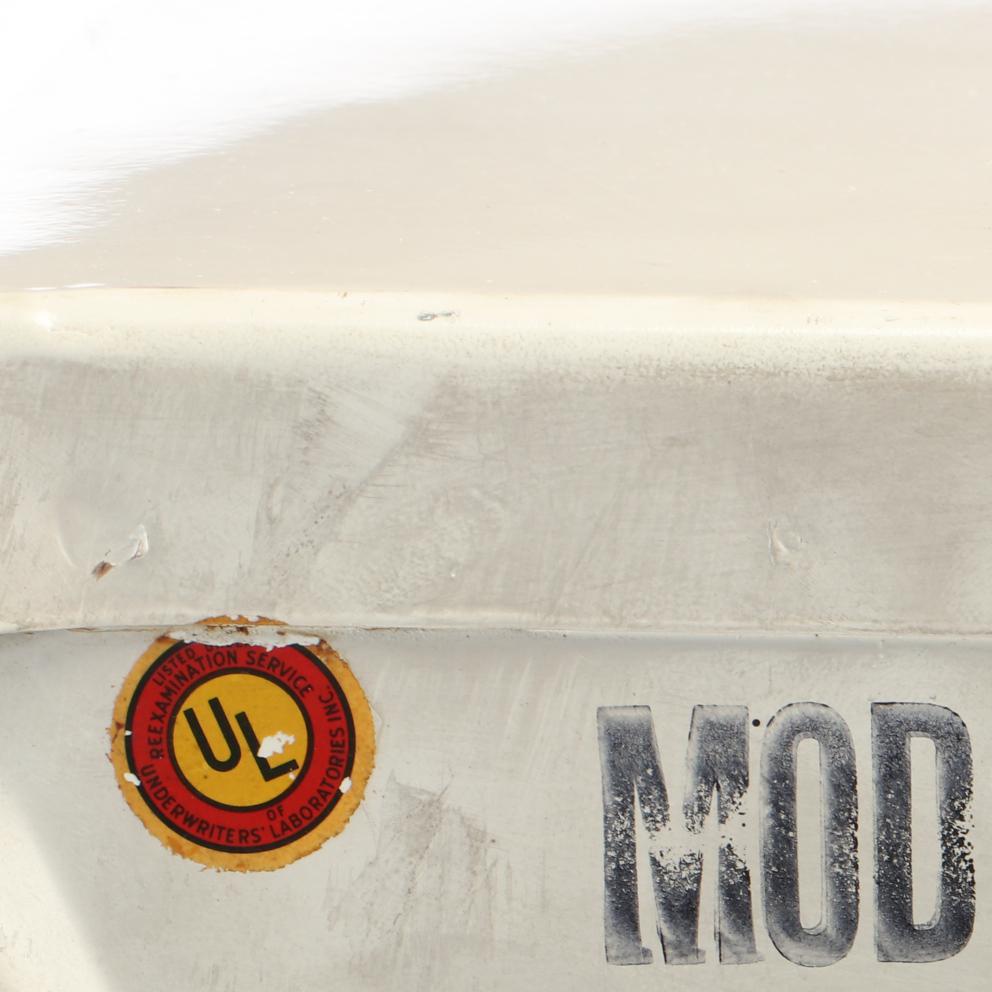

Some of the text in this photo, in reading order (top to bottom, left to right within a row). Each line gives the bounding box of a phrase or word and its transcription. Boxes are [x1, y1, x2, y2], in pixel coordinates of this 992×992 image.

[148, 650, 313, 759] REEXAMINATION SERVICE
[152, 647, 197, 688] LISTED
[183, 697, 299, 782] UL
[266, 805, 285, 822] OF
[269, 727, 346, 839] LABORATORIES
